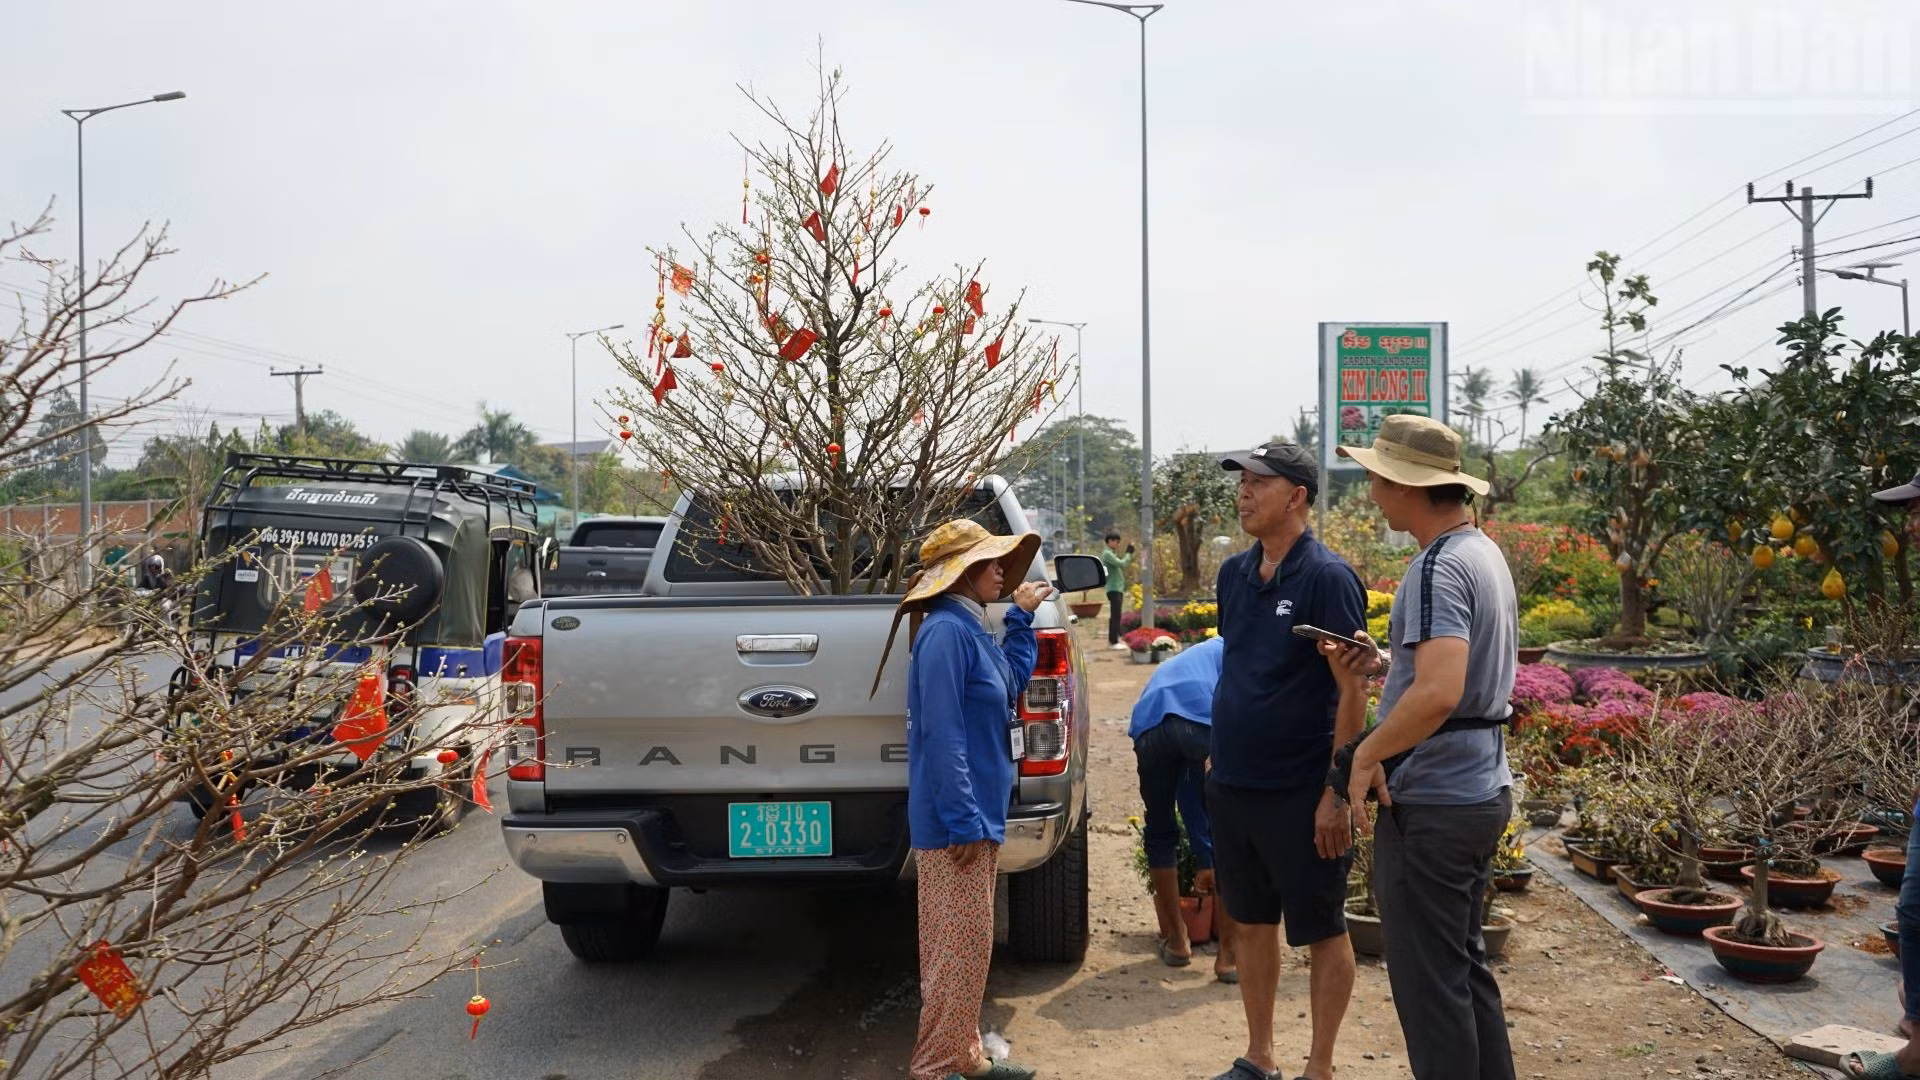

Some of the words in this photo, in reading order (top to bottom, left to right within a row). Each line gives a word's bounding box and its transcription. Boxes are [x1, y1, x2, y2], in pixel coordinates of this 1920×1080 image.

[1378, 355, 1425, 367] LANDSCAPE
[1341, 369, 1368, 402] KIM
[1369, 369, 1409, 402] LONG
[1411, 369, 1427, 402] III
[307, 531, 319, 546] 94
[320, 532, 338, 547] 070
[760, 694, 792, 708] Ford
[565, 744, 909, 767] RANGE
